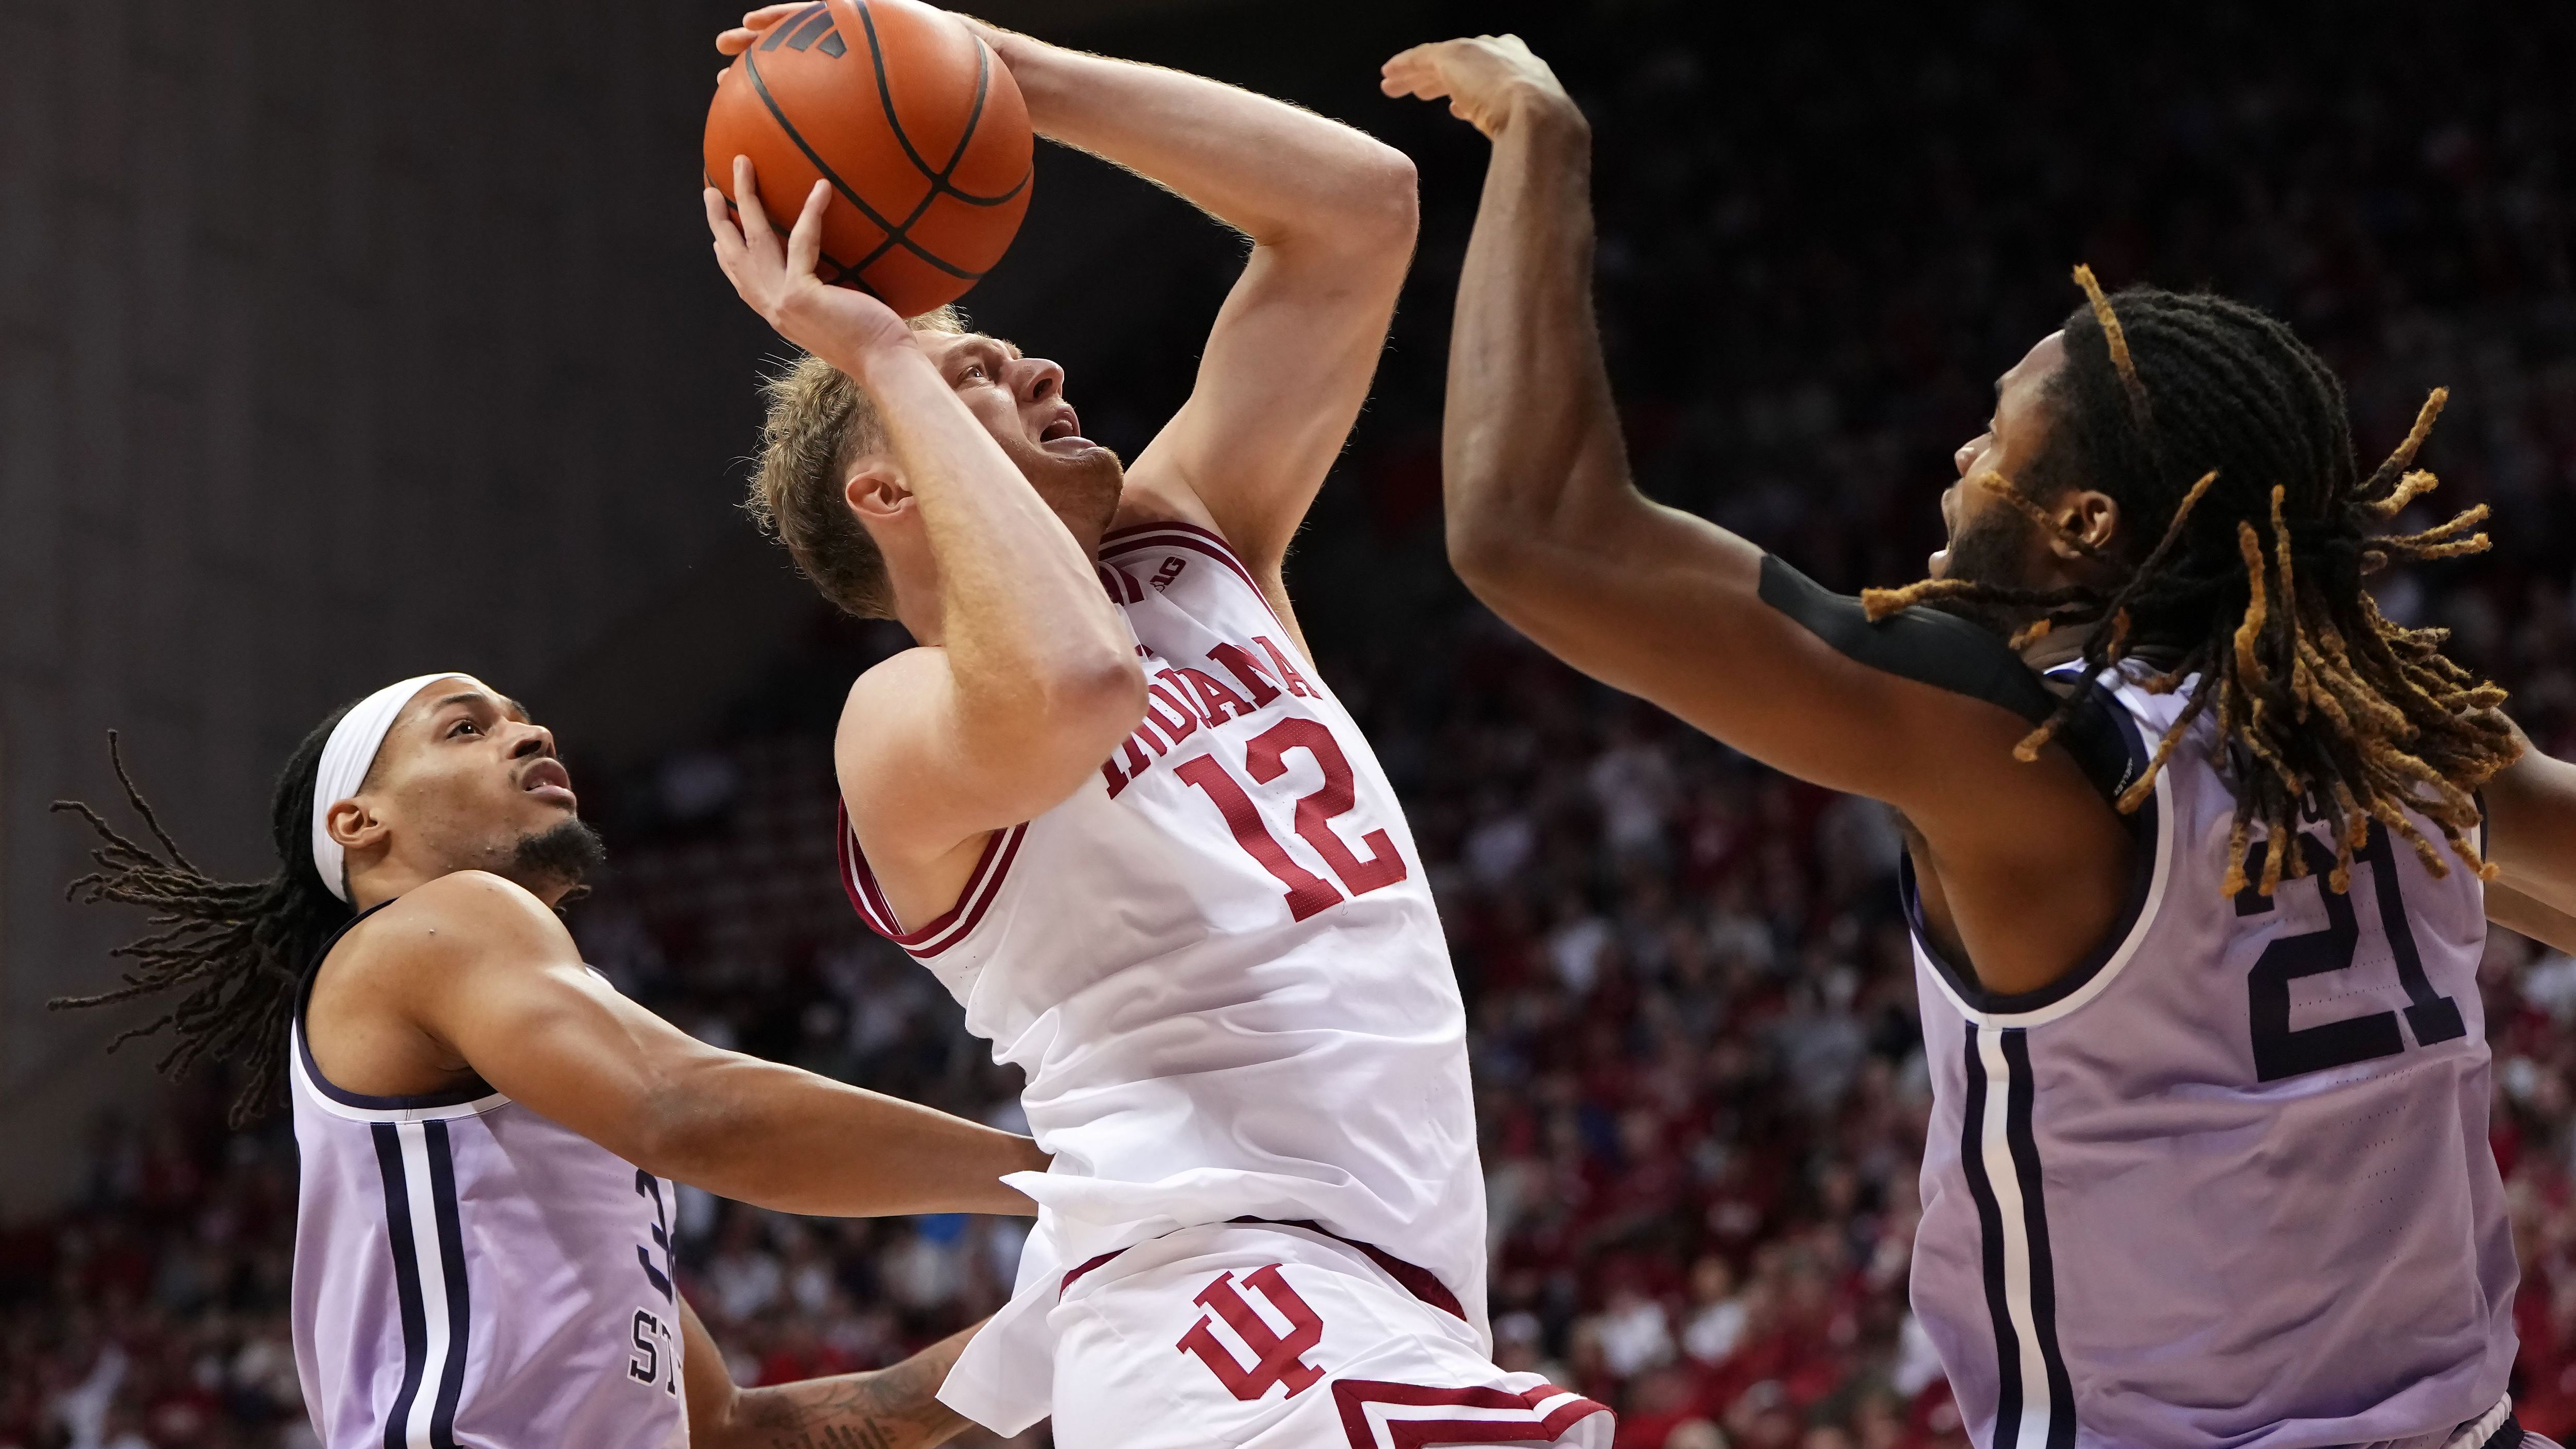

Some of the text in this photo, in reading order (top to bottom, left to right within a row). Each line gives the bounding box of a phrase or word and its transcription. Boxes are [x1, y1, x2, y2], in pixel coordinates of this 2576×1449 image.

[1174, 717, 1407, 922] 12
[2235, 815, 2466, 1082] 21
[635, 1168, 675, 1305] 3
[628, 1306, 682, 1399] ST
